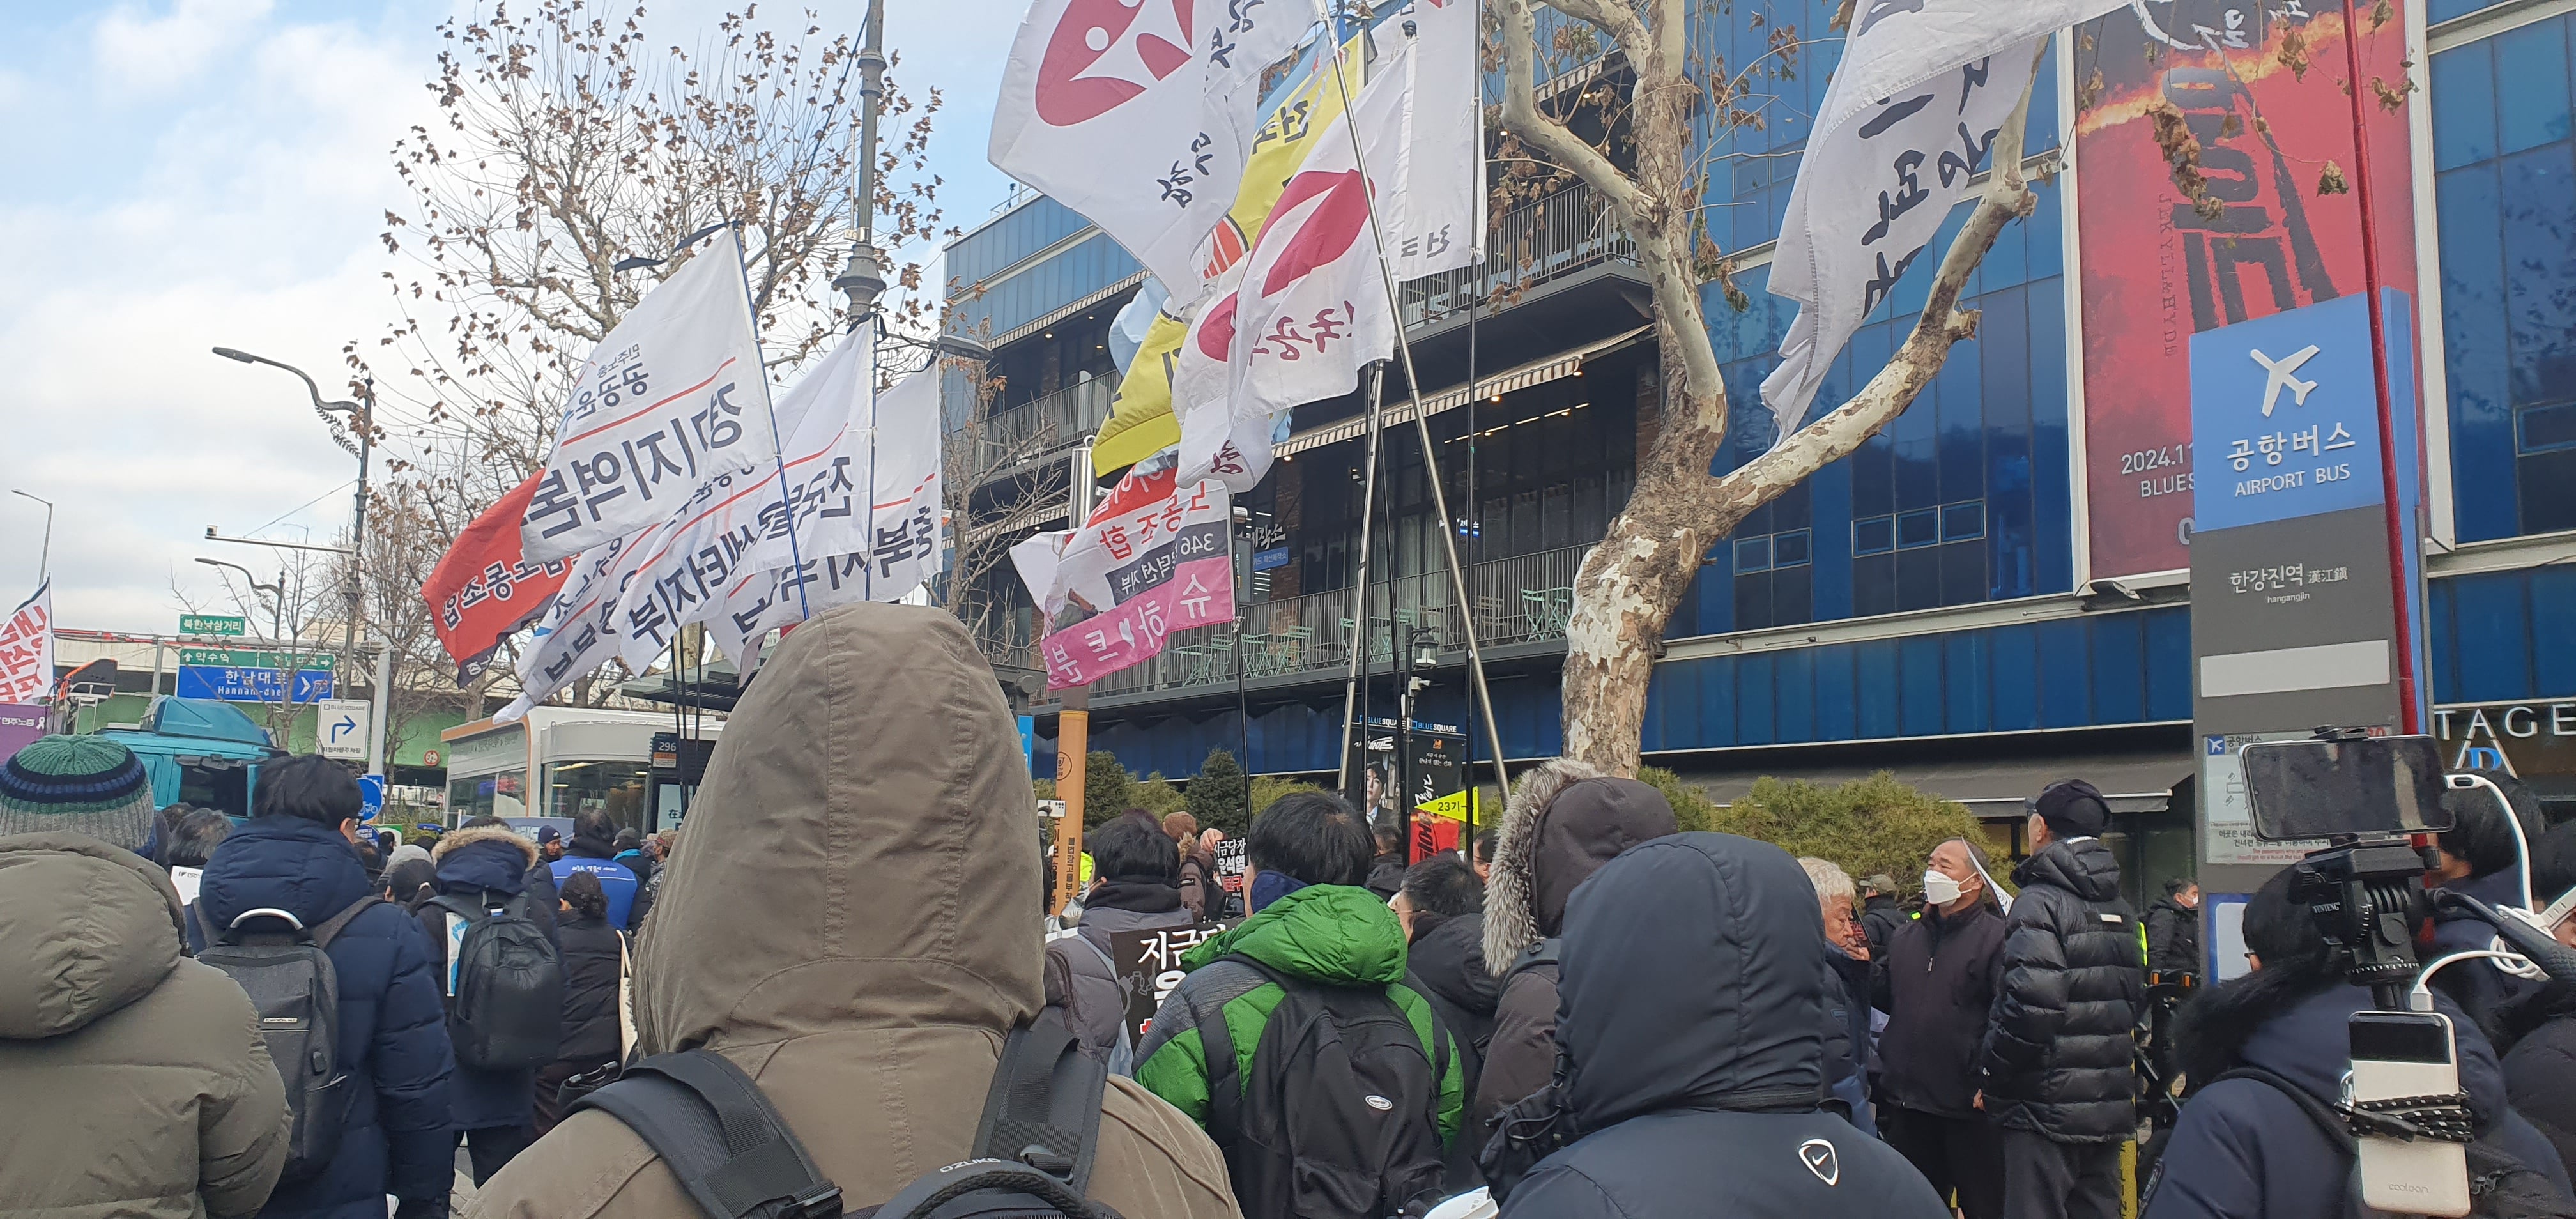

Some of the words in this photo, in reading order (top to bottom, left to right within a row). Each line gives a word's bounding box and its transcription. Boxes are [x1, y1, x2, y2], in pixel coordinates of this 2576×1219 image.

[2227, 422, 2356, 471] 공항버스
[2235, 470, 2306, 497] AIRPORT
[2315, 463, 2351, 486] BUS
[2230, 564, 2303, 594] 한강진역
[2267, 592, 2310, 604] hangangjin
[183, 618, 242, 631] 북한남삼거리
[195, 652, 230, 663] 약수역
[225, 671, 288, 685] 한남대로
[218, 686, 287, 696] Hannam-dae
[1368, 717, 1397, 726] BLUESQUA
[1418, 722, 1457, 733] BLUESQUARE
[659, 742, 676, 752] 296
[1218, 855, 1245, 875] 윤석열
[939, 1158, 1002, 1173] OZUKO
